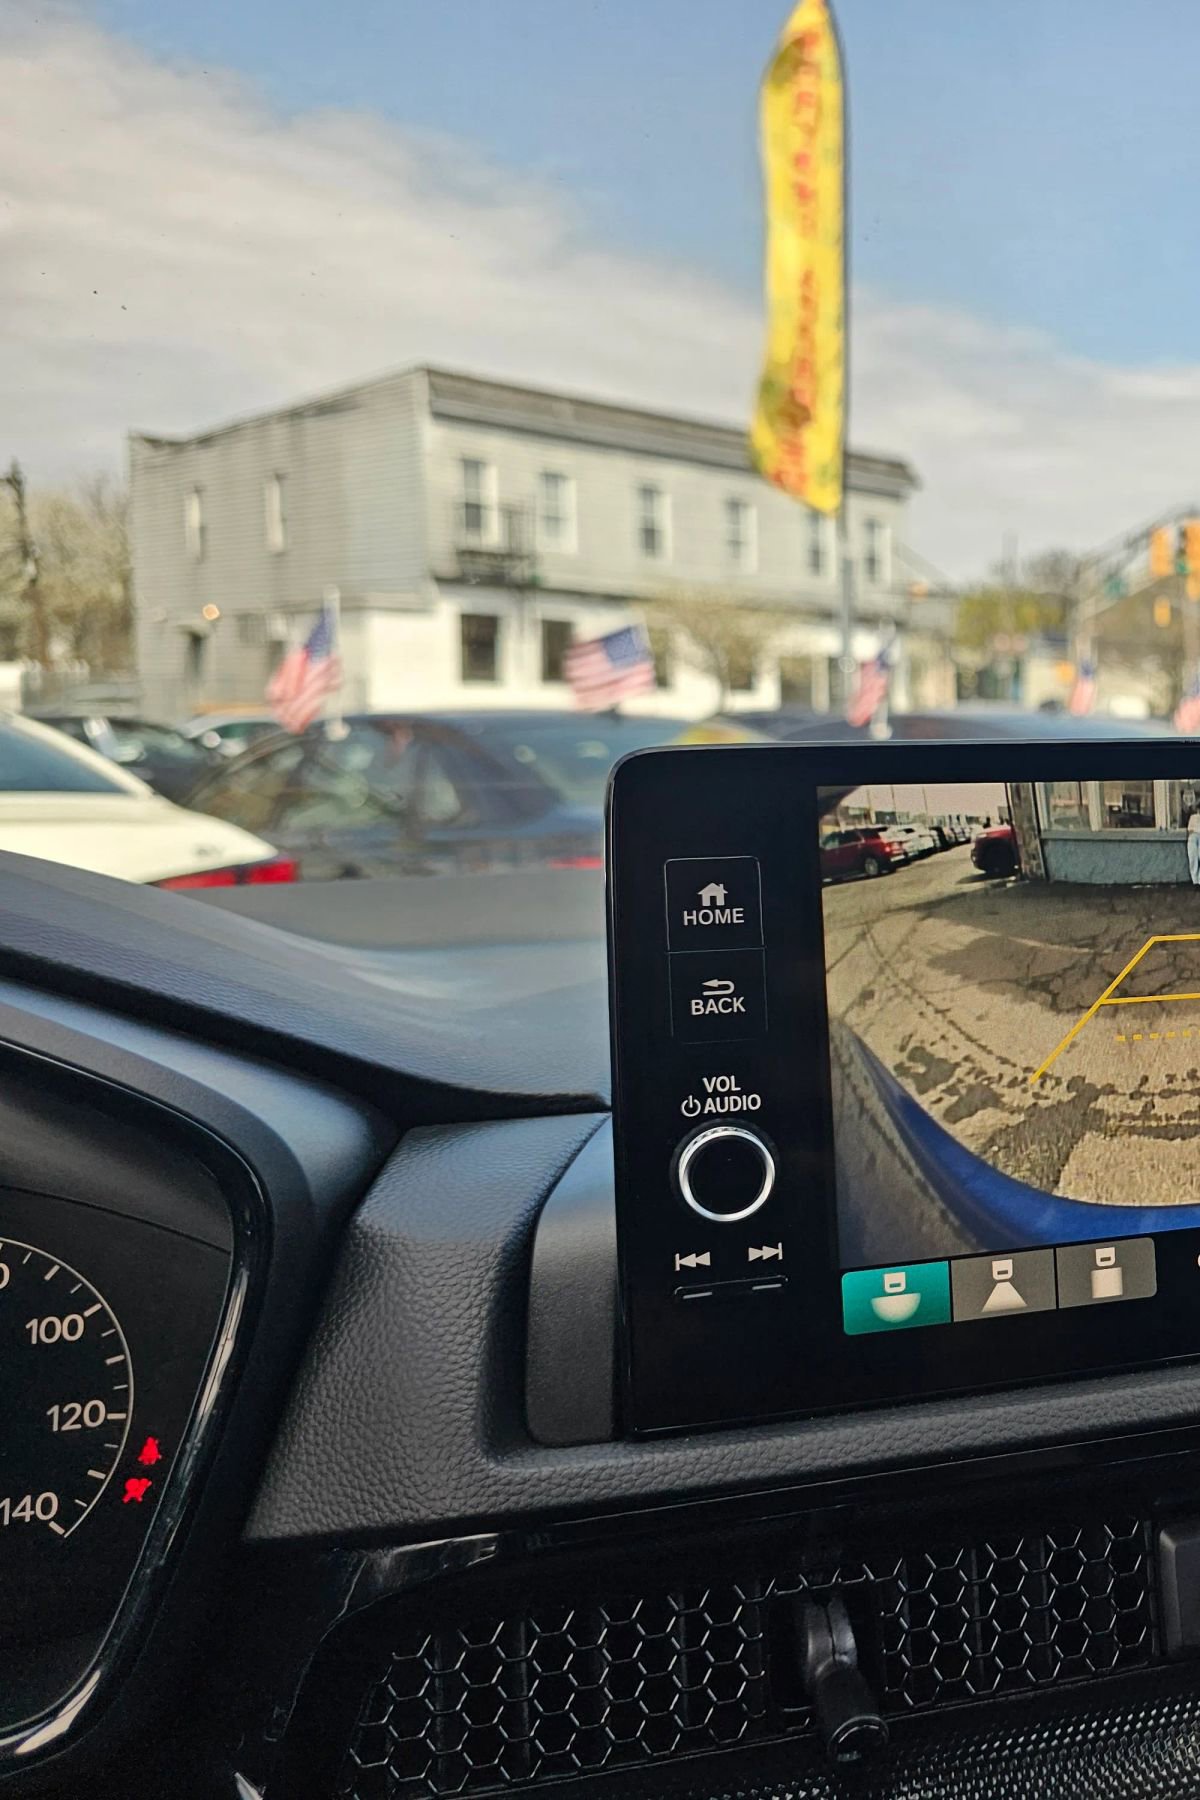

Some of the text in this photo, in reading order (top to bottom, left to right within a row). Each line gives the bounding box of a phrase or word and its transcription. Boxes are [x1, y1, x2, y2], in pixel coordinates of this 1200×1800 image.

[684, 907, 745, 926] HOME
[691, 996, 746, 1016] BACK
[702, 1075, 742, 1093] VOL
[703, 1093, 762, 1114] AUDIO
[26, 1313, 85, 1345] 100
[46, 1399, 105, 1432] 120
[0, 1491, 59, 1526] 140
